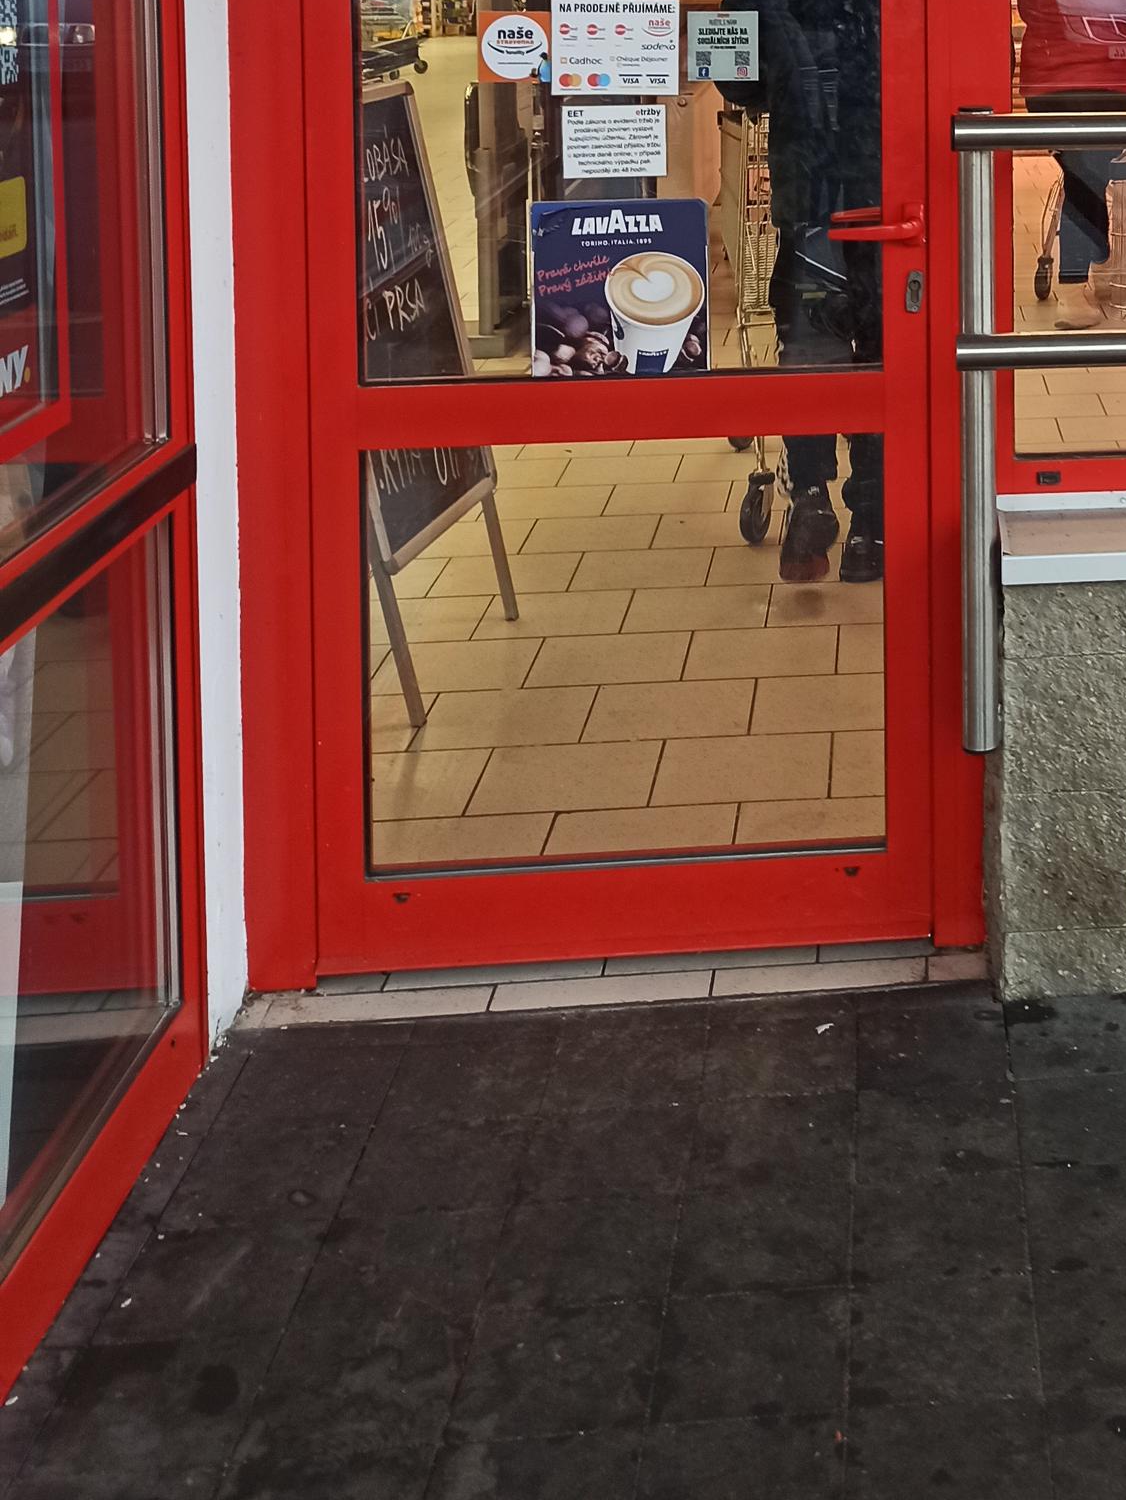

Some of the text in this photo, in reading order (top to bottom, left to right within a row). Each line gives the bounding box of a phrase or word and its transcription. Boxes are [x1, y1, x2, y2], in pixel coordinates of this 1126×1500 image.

[559, 2, 676, 14] NA PRODEJNĚ PŘIJÍMÁME:
[497, 26, 534, 39] naše
[569, 56, 603, 65] Cadhoc
[571, 209, 664, 236] LAVAZZA
[382, 277, 428, 332] PRSA
